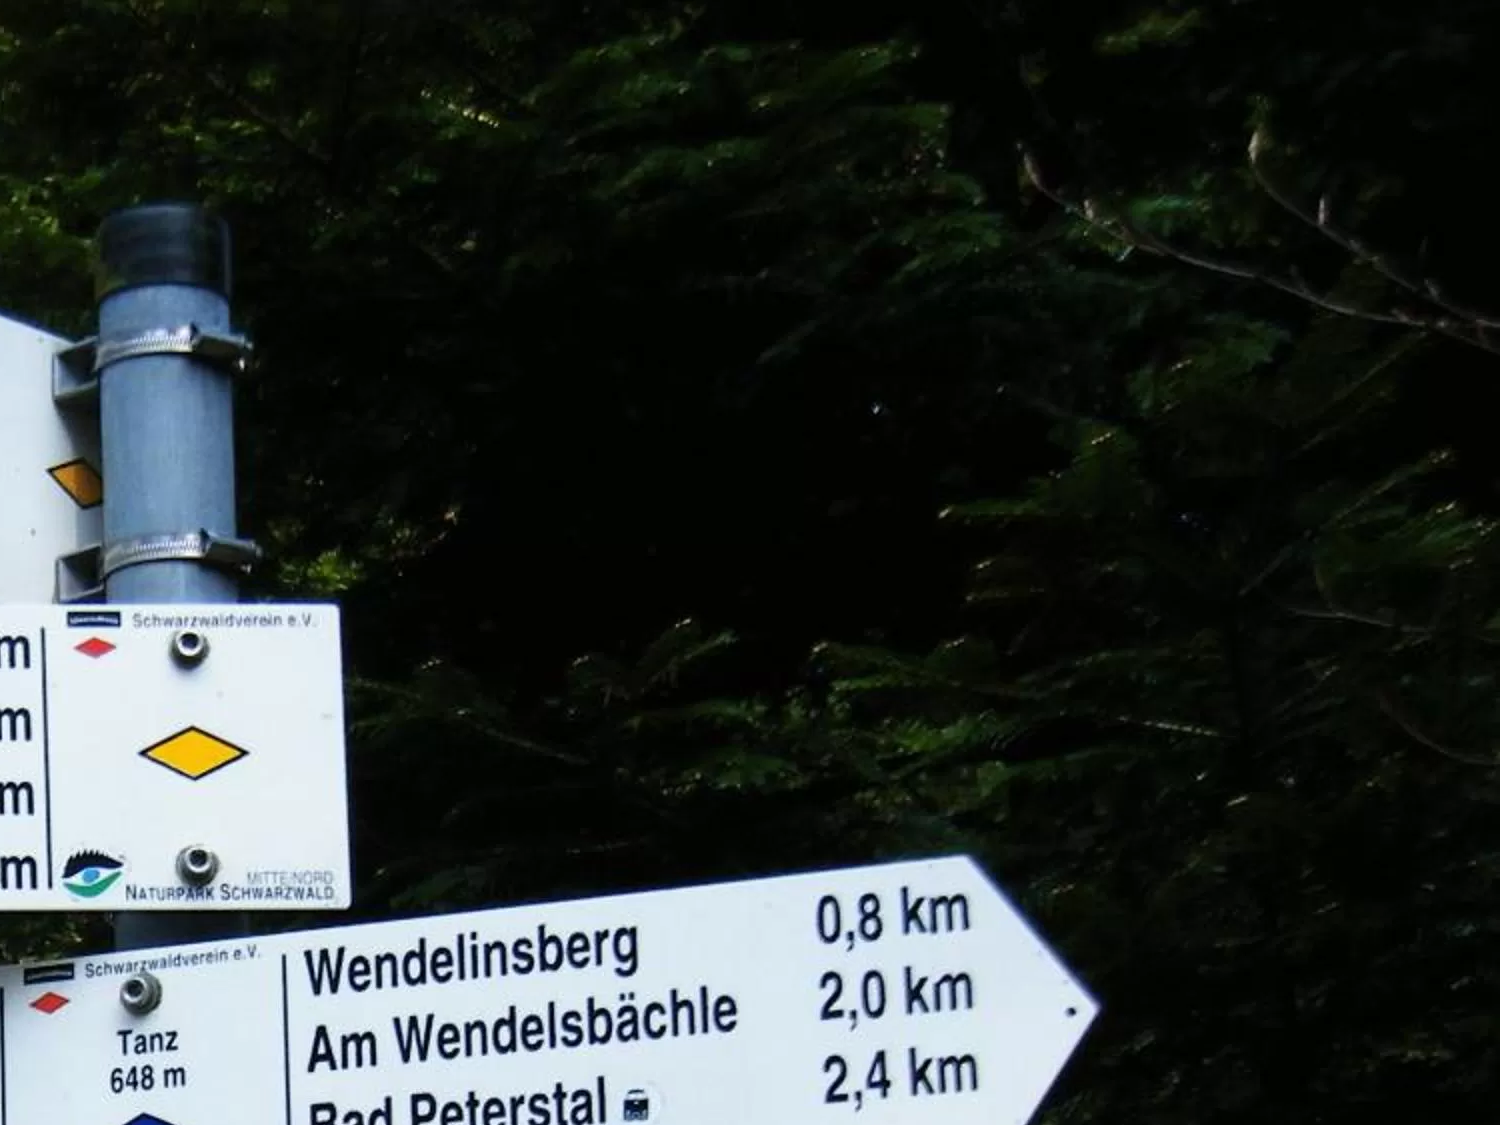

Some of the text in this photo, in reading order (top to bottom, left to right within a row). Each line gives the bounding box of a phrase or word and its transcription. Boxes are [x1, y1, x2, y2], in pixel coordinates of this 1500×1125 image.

[132, 613, 282, 629] Schwarzwaldverein
[126, 884, 334, 900] NATURPARK SCHWARZWALD
[304, 887, 970, 996] Wendelinsberg 0,8 km
[85, 949, 229, 978] Schwarzwaldverein
[308, 966, 973, 1073] Am Wendelsbächle 2,0 km
[117, 1029, 178, 1056] Tanz
[110, 1065, 186, 1094] 648 m
[823, 1050, 891, 1111] 2,4
[909, 1047, 978, 1096] km
